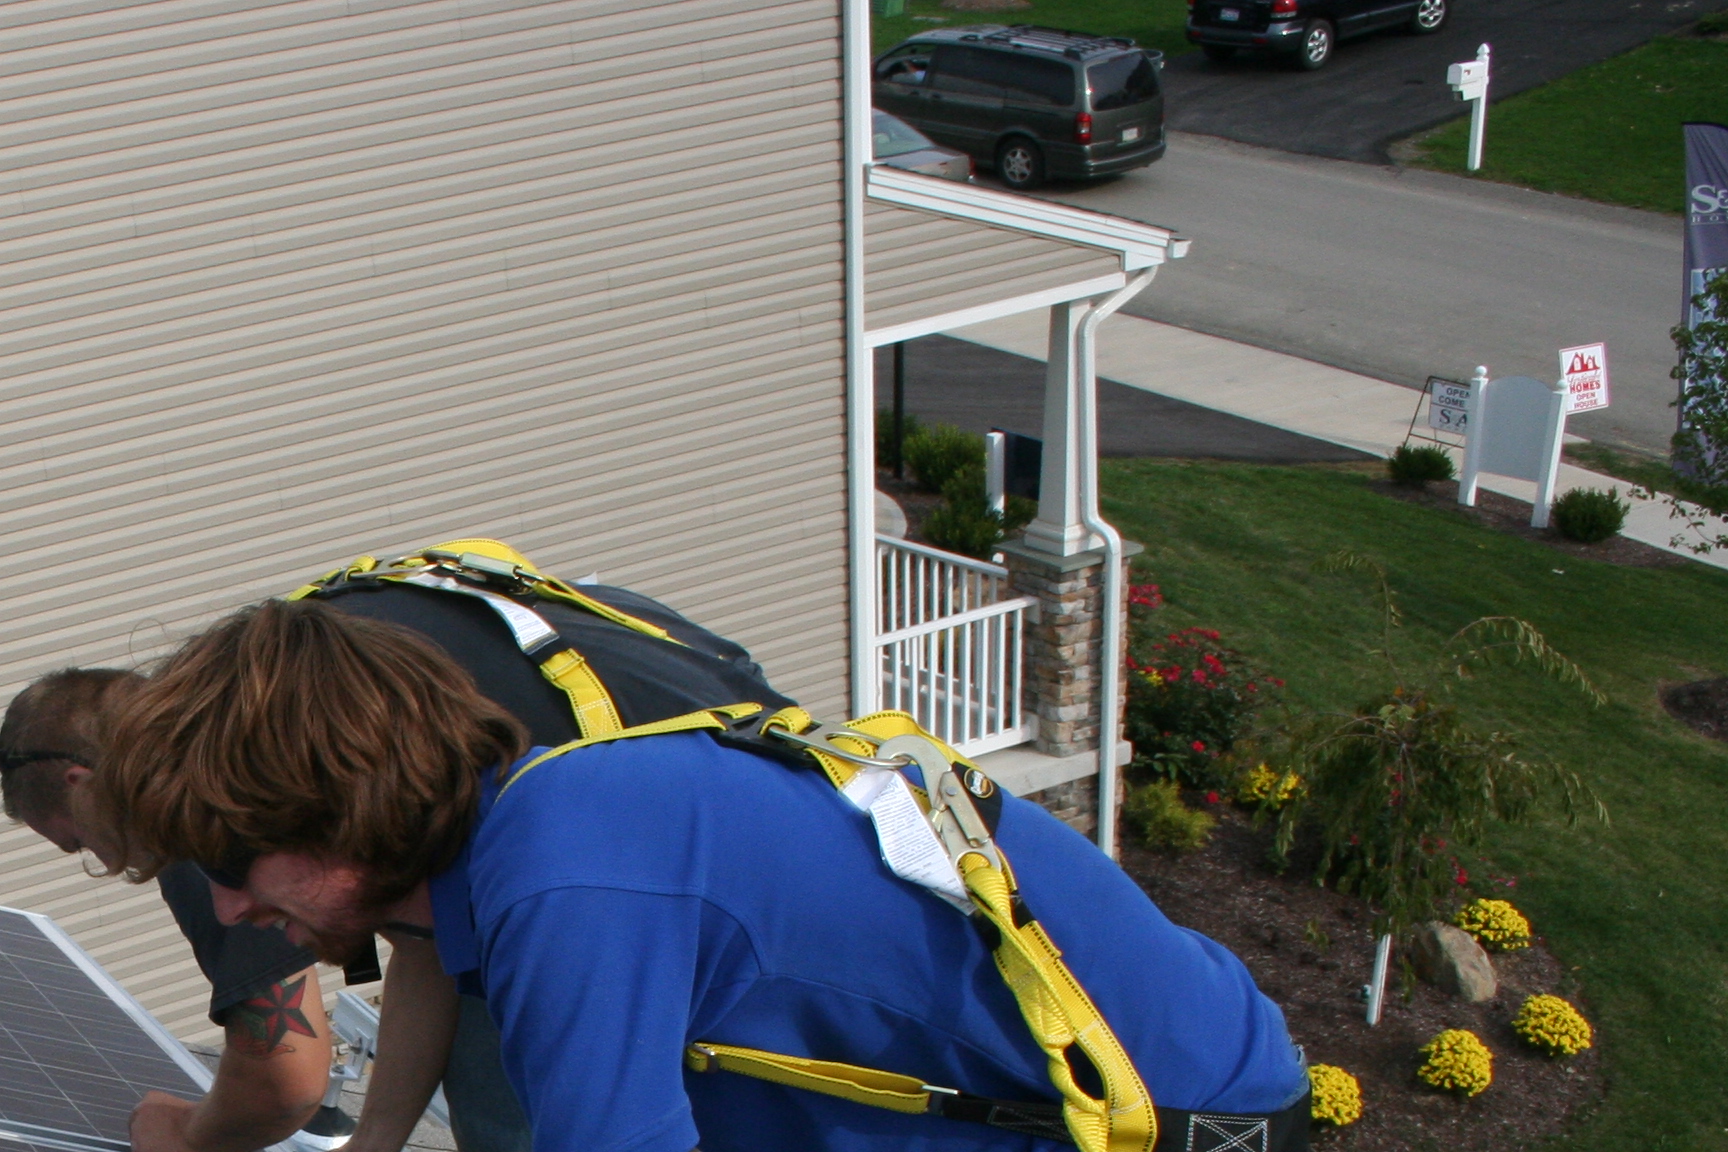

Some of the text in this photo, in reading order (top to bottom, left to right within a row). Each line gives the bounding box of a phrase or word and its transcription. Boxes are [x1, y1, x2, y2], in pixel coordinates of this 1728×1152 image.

[1692, 215, 1728, 223] HO
[1569, 380, 1601, 394] HOMES
[1438, 395, 1466, 407] COME
[1576, 392, 1596, 401] OPEN
